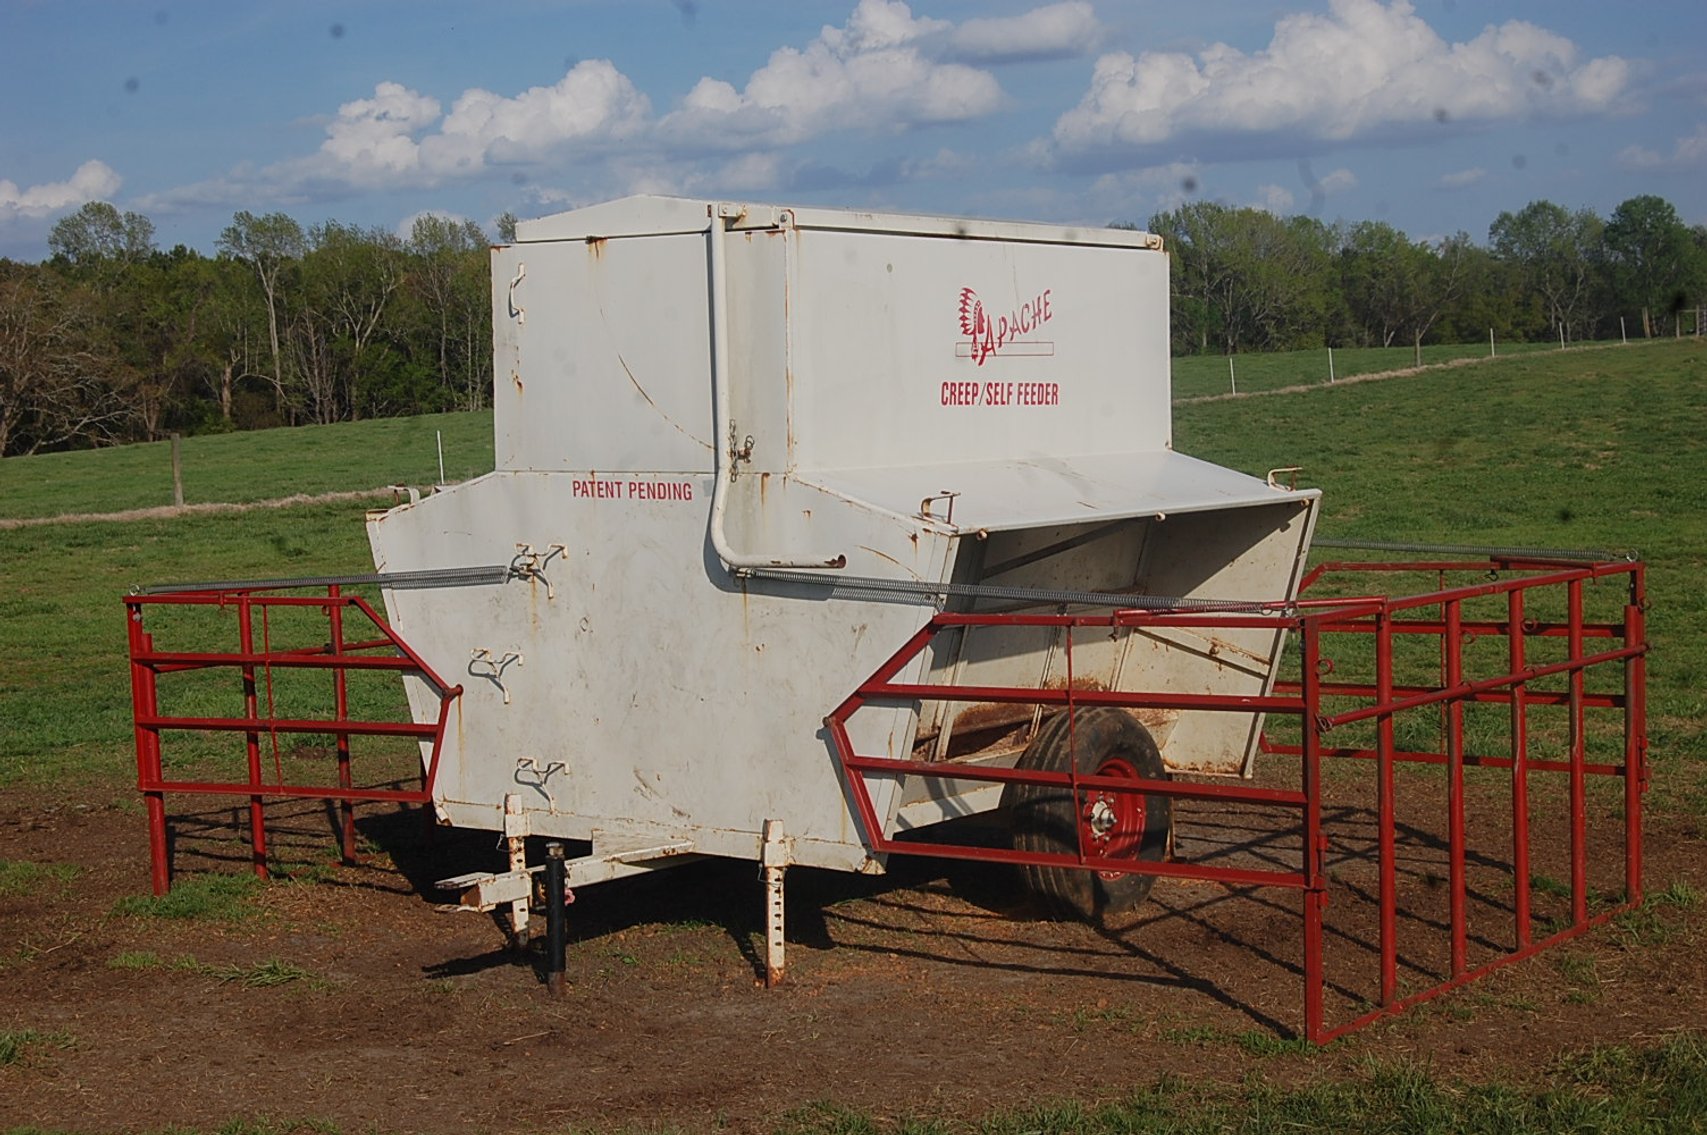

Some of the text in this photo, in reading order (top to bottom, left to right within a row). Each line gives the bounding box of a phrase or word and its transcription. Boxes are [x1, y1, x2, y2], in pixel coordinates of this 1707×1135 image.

[978, 289, 1053, 366] APACHE
[941, 381, 1059, 406] CREEP/SELF FEEDER
[572, 480, 692, 501] PATENT PENDING
